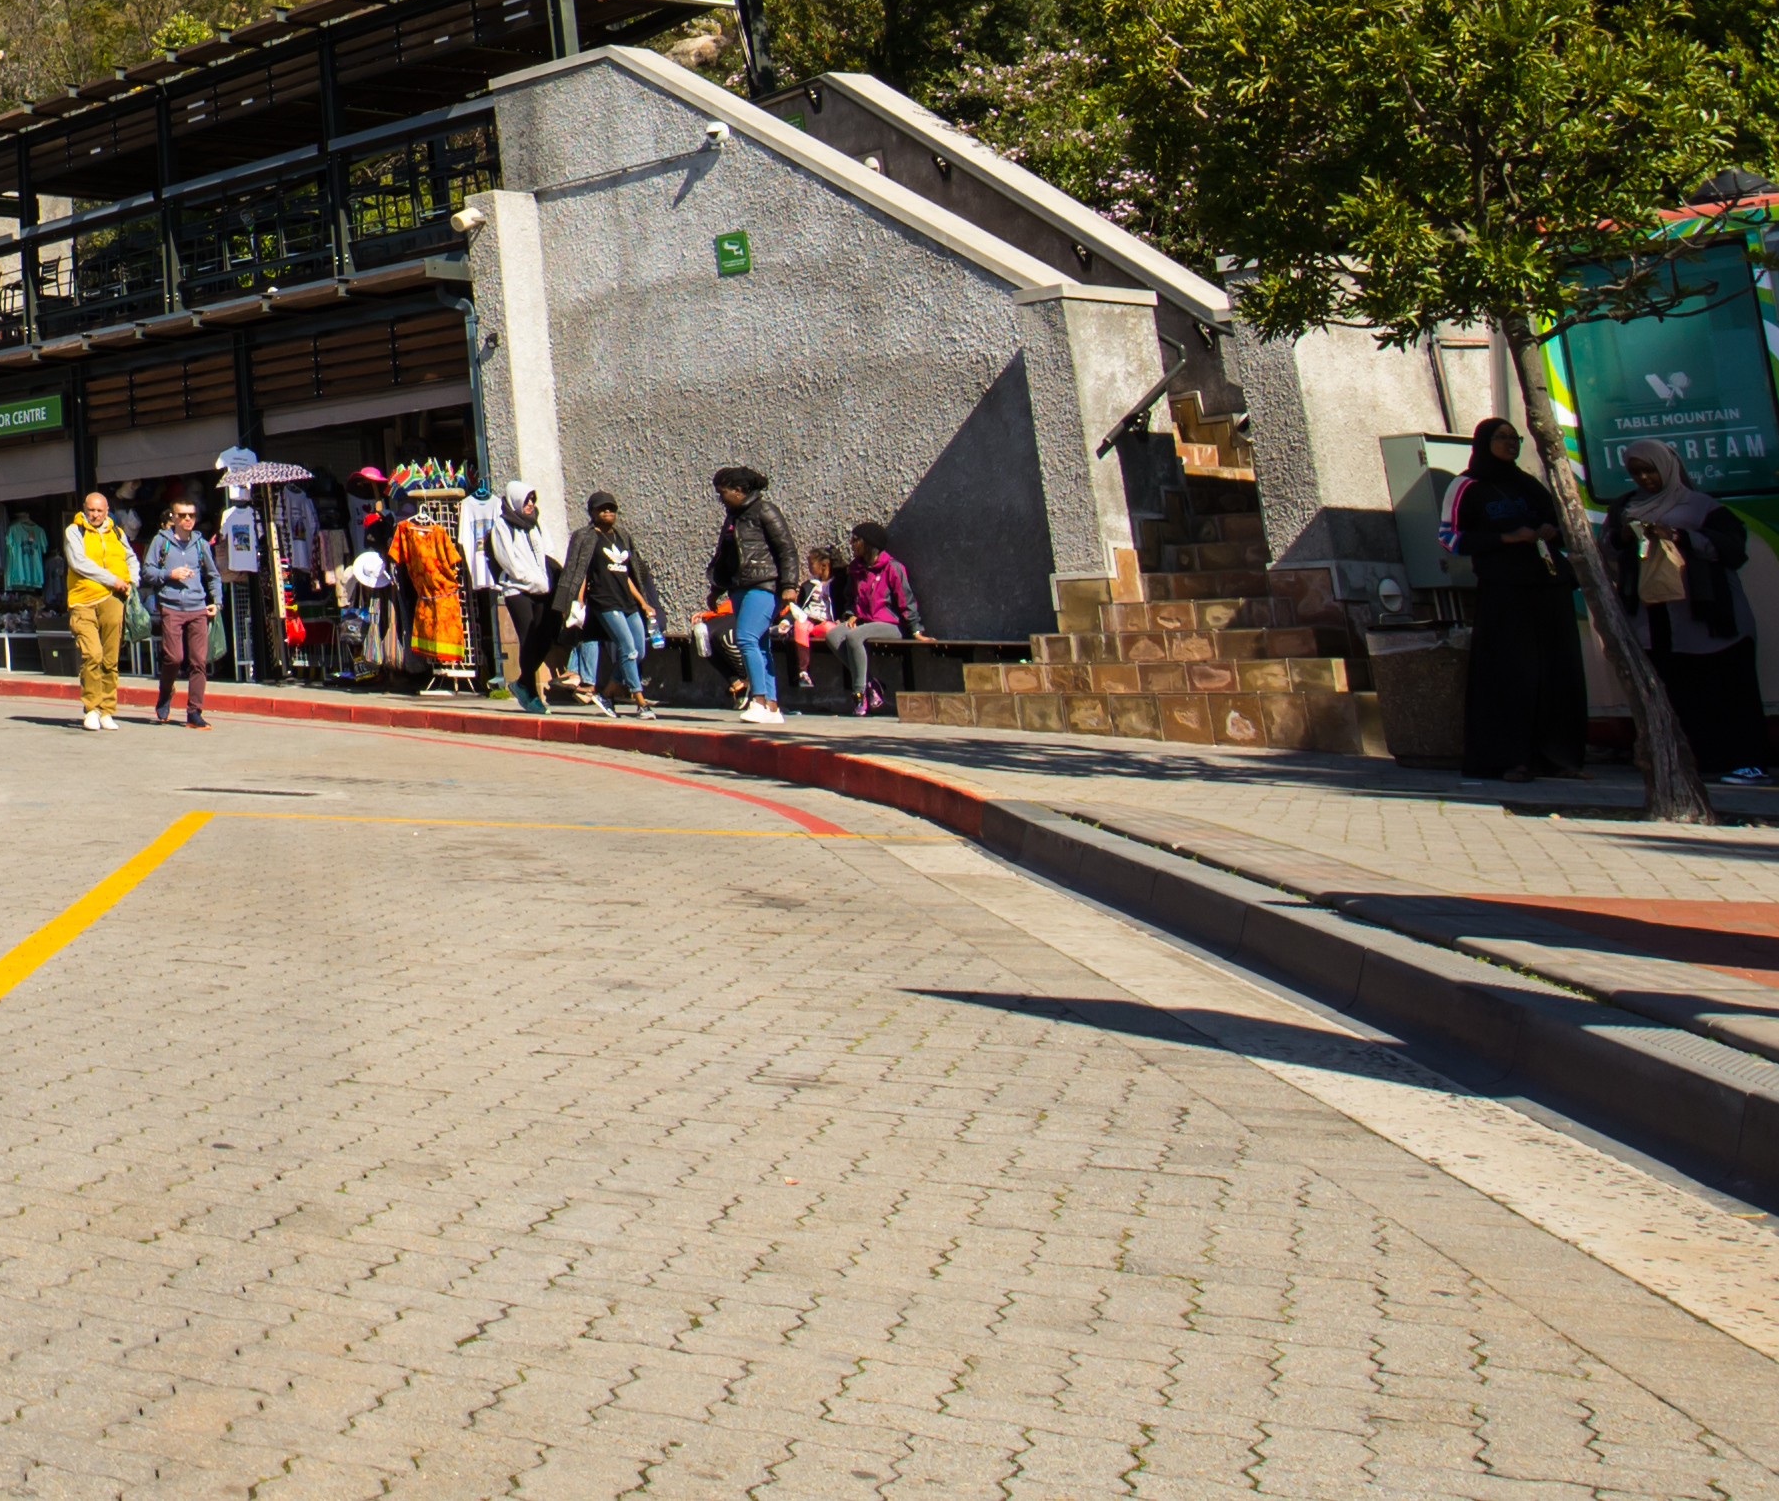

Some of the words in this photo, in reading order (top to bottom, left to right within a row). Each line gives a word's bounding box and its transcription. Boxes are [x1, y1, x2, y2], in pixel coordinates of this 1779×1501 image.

[12, 406, 47, 425] CENTRE
[1614, 414, 1660, 430] TABLE
[1661, 407, 1741, 427] MOUNTAIN
